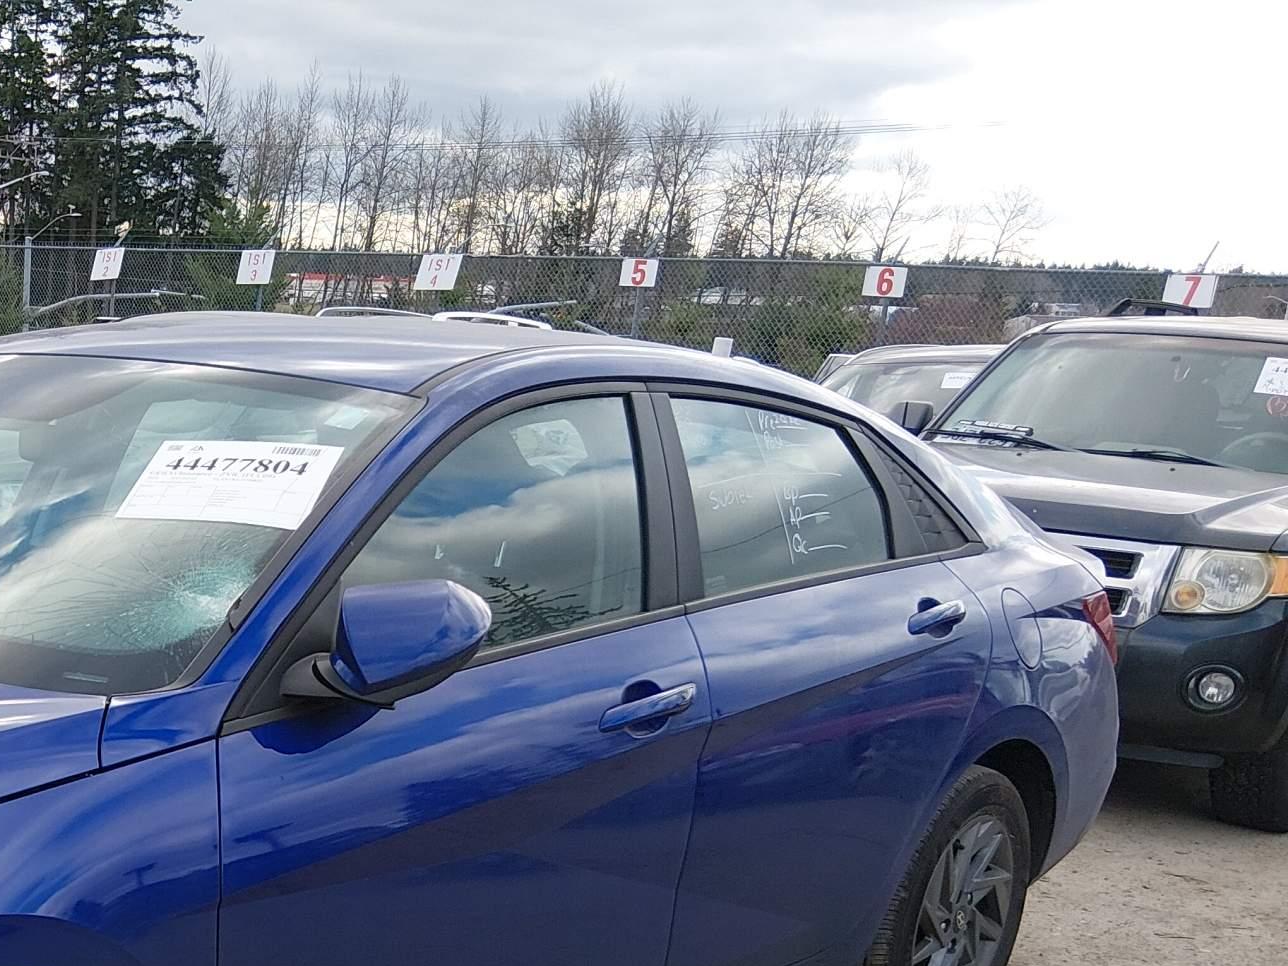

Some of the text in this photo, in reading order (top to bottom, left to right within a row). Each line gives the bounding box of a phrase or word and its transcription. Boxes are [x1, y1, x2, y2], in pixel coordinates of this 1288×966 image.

[101, 266, 109, 277] 2
[250, 269, 257, 282] 3
[430, 275, 438, 288] 4
[631, 258, 648, 285] 5
[876, 267, 894, 296] 6
[1182, 275, 1202, 307] 7
[166, 456, 310, 476] 44477804
